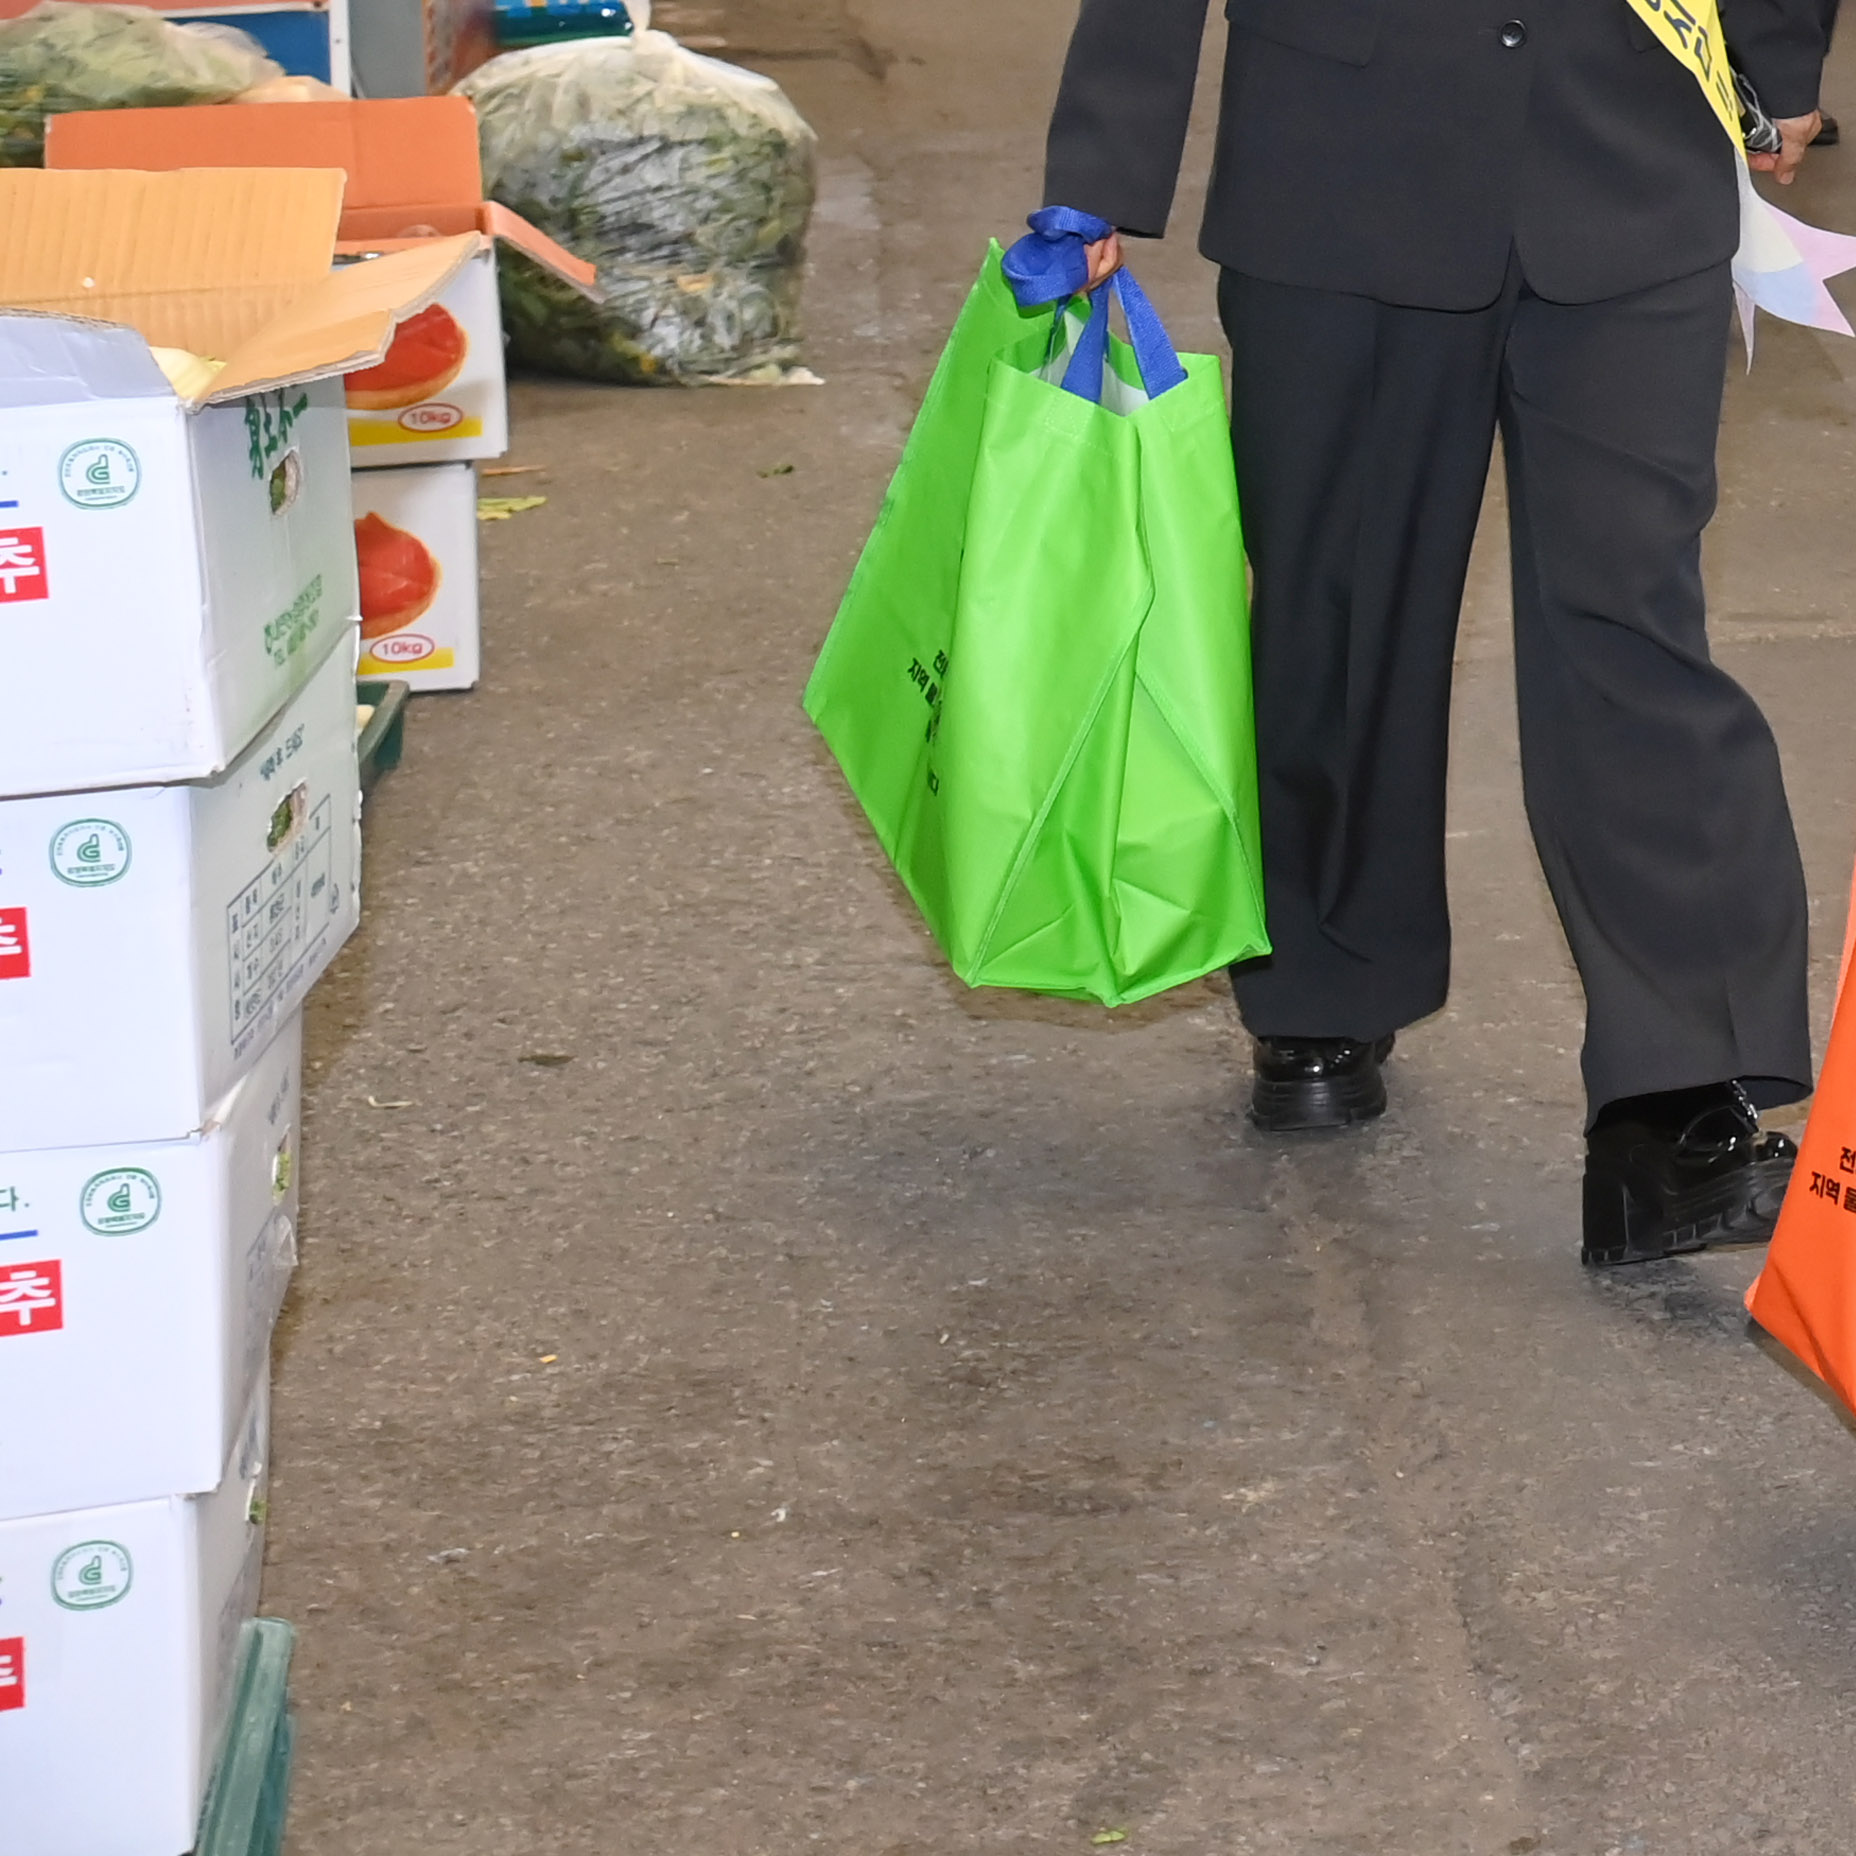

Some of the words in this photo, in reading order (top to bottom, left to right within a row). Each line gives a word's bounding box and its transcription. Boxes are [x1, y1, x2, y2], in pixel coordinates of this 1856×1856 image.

[408, 406, 455, 427] 10kg
[381, 637, 425, 658] 10kg
[1809, 1170, 1841, 1206] 지역
